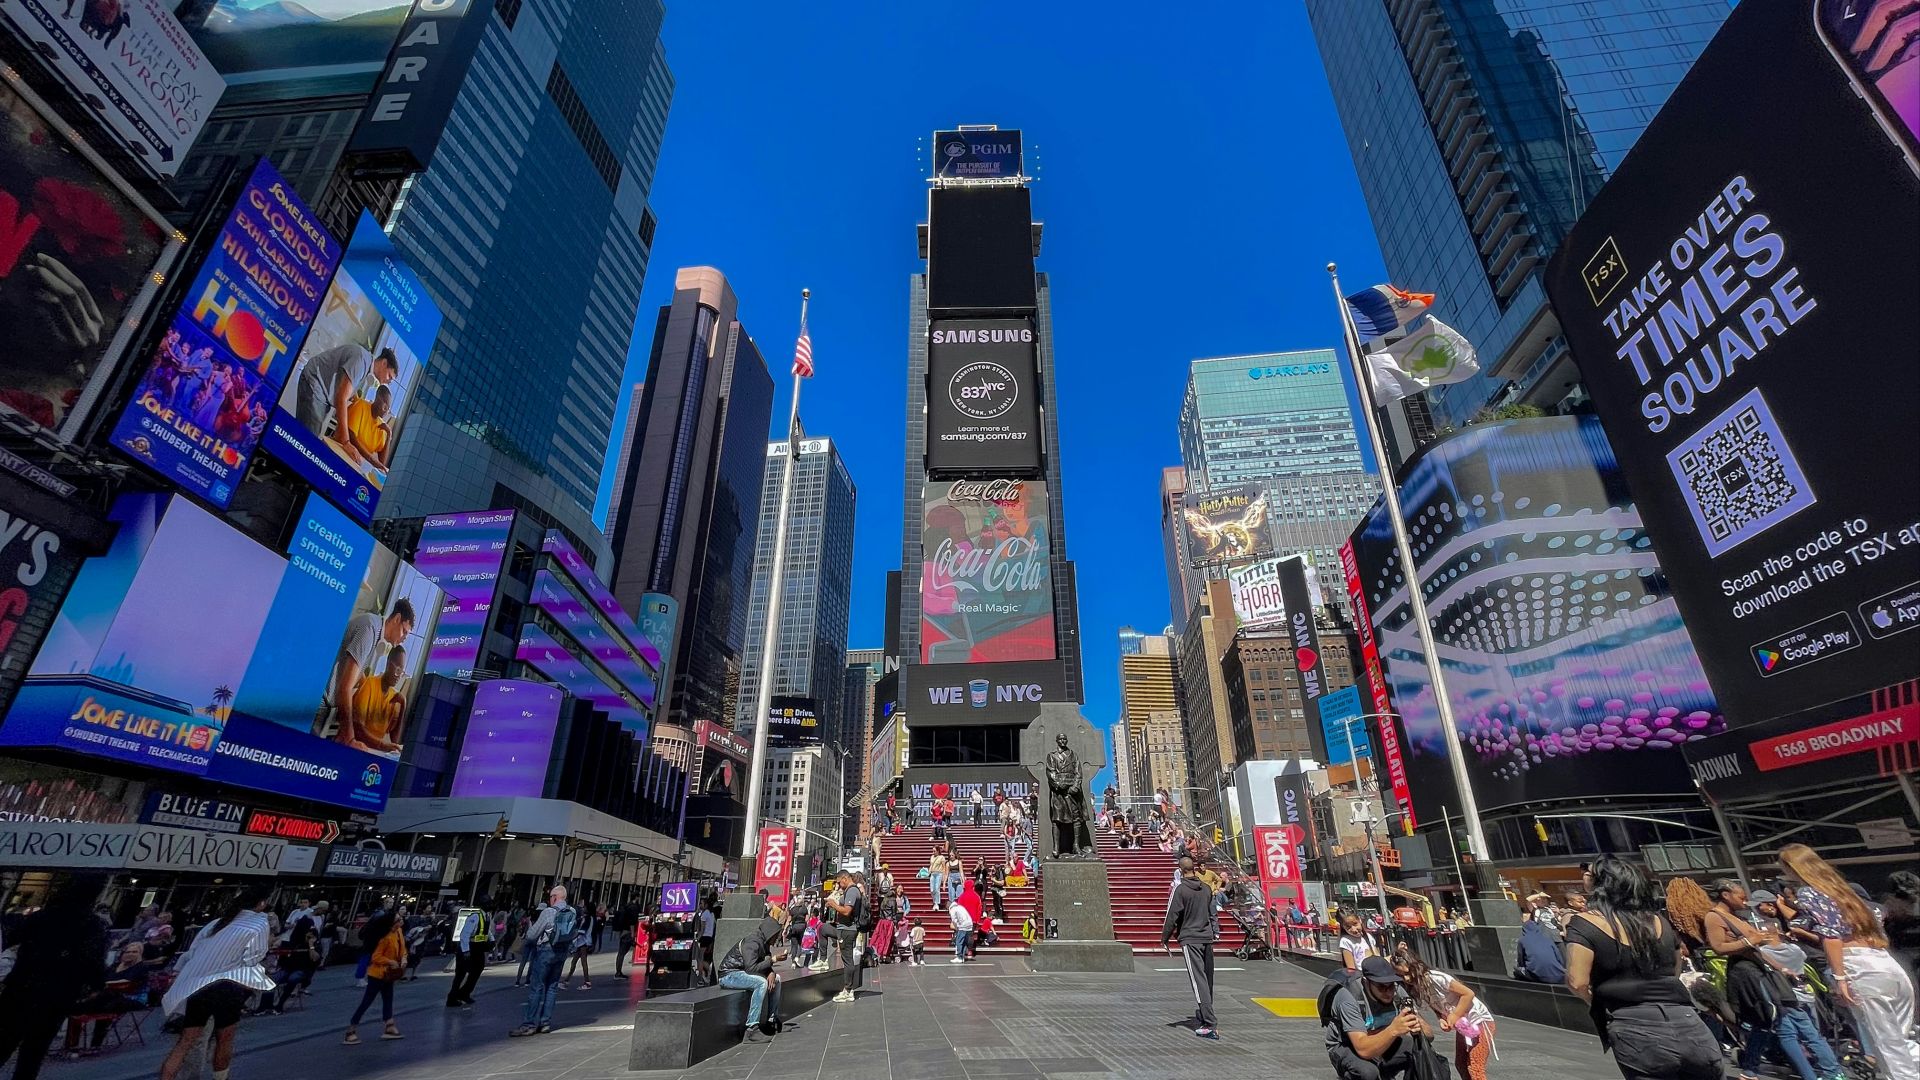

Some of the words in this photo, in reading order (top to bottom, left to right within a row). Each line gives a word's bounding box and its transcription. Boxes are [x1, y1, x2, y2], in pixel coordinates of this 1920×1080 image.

[144, 4, 197, 71] PHENOMENON
[129, 33, 161, 71] THAT
[160, 72, 199, 122] GOES
[141, 31, 165, 58] THE
[165, 58, 202, 100] PLAY
[53, 31, 89, 67] STAGES
[91, 71, 110, 91] 340
[136, 121, 165, 151] STREET
[120, 41, 193, 135] WRONG
[972, 144, 1012, 154] PGIM
[1591, 255, 1618, 287] TSX
[1603, 261, 1671, 339] TAKE
[1670, 176, 1755, 270] OVER
[380, 270, 414, 314] smarter
[384, 256, 418, 305] creating
[215, 268, 229, 283] BUT
[229, 282, 266, 317] EVERYONE
[266, 315, 286, 337] LOVES
[372, 281, 412, 333] summers
[1616, 214, 1784, 385] TIMES
[194, 278, 287, 376] HOT
[933, 329, 1032, 343] SAMSUNG
[1641, 267, 1817, 432] SQUARE
[955, 365, 991, 383] WASHINGTON
[991, 366, 1012, 382] STREET
[984, 382, 1005, 391] NYC
[1265, 362, 1329, 379] BARCLAYS
[956, 398, 967, 409] NEW
[961, 387, 987, 399] 837
[136, 391, 175, 424] SOME
[212, 438, 246, 469] HOT
[941, 432, 1027, 442] samsung.com/837
[151, 423, 192, 454] SHUBERT
[192, 449, 228, 479] THEATRE
[273, 423, 347, 488] SUMMERLEARNING.ORG
[28, 467, 71, 495] PRIME
[947, 479, 1023, 501] Coca-Cola
[1211, 487, 1244, 497] BROADWAY
[1723, 467, 1744, 485] TSX
[307, 519, 353, 558] creating
[430, 517, 456, 528] Stanley
[467, 515, 494, 525] Morgan
[300, 535, 346, 572] smarter
[426, 546, 453, 555] Morgan
[453, 543, 480, 553] Stanley
[932, 537, 1041, 592] Coca-Cola
[1722, 569, 1763, 596] Scan
[1762, 553, 1793, 578] the
[1795, 528, 1842, 562] code
[1843, 518, 1868, 538] to
[293, 554, 347, 594] summers
[453, 573, 480, 583] Morgan
[1238, 562, 1276, 586] LITTLE
[1732, 571, 1813, 619] download
[1812, 558, 1846, 583] the
[1845, 532, 1897, 566] TSX
[959, 604, 982, 612] Real
[1292, 611, 1311, 647] NYC
[1779, 638, 1791, 648] GET
[1797, 632, 1807, 642] ON
[1784, 641, 1825, 662] Google
[1824, 630, 1850, 652] Play
[929, 687, 963, 704] WE
[996, 684, 1042, 702] NYC
[1303, 669, 1320, 700] WE
[1368, 657, 1384, 694] FREE
[70, 696, 124, 731] SOME
[176, 717, 220, 753] HOT
[784, 708, 794, 716] OR
[72, 727, 110, 748] SHUBERT
[110, 734, 141, 754] THEATRE
[148, 745, 209, 767] TELECHARGE.COM
[1375, 693, 1407, 788] CHOCOLATE
[1774, 741, 1807, 758] 1568
[1809, 718, 1903, 751] BROADWAY
[215, 740, 338, 782] SUMMERLEARNING.ORG
[159, 793, 211, 817] BLUE
[214, 802, 245, 822] FIN
[911, 784, 932, 798] WE
[950, 783, 983, 797] THAT
[1002, 783, 1028, 797] YOU
[1284, 789, 1300, 822] NYC
[248, 813, 275, 834] DOS
[275, 816, 325, 840] CAMINOS
[133, 832, 283, 871] SWAROVSKI
[332, 852, 358, 865] BLUE
[361, 854, 378, 867] FIN
[381, 853, 410, 869] NOW
[411, 855, 440, 872] OPEN
[765, 833, 787, 878] tkts
[1265, 830, 1289, 878] tkts
